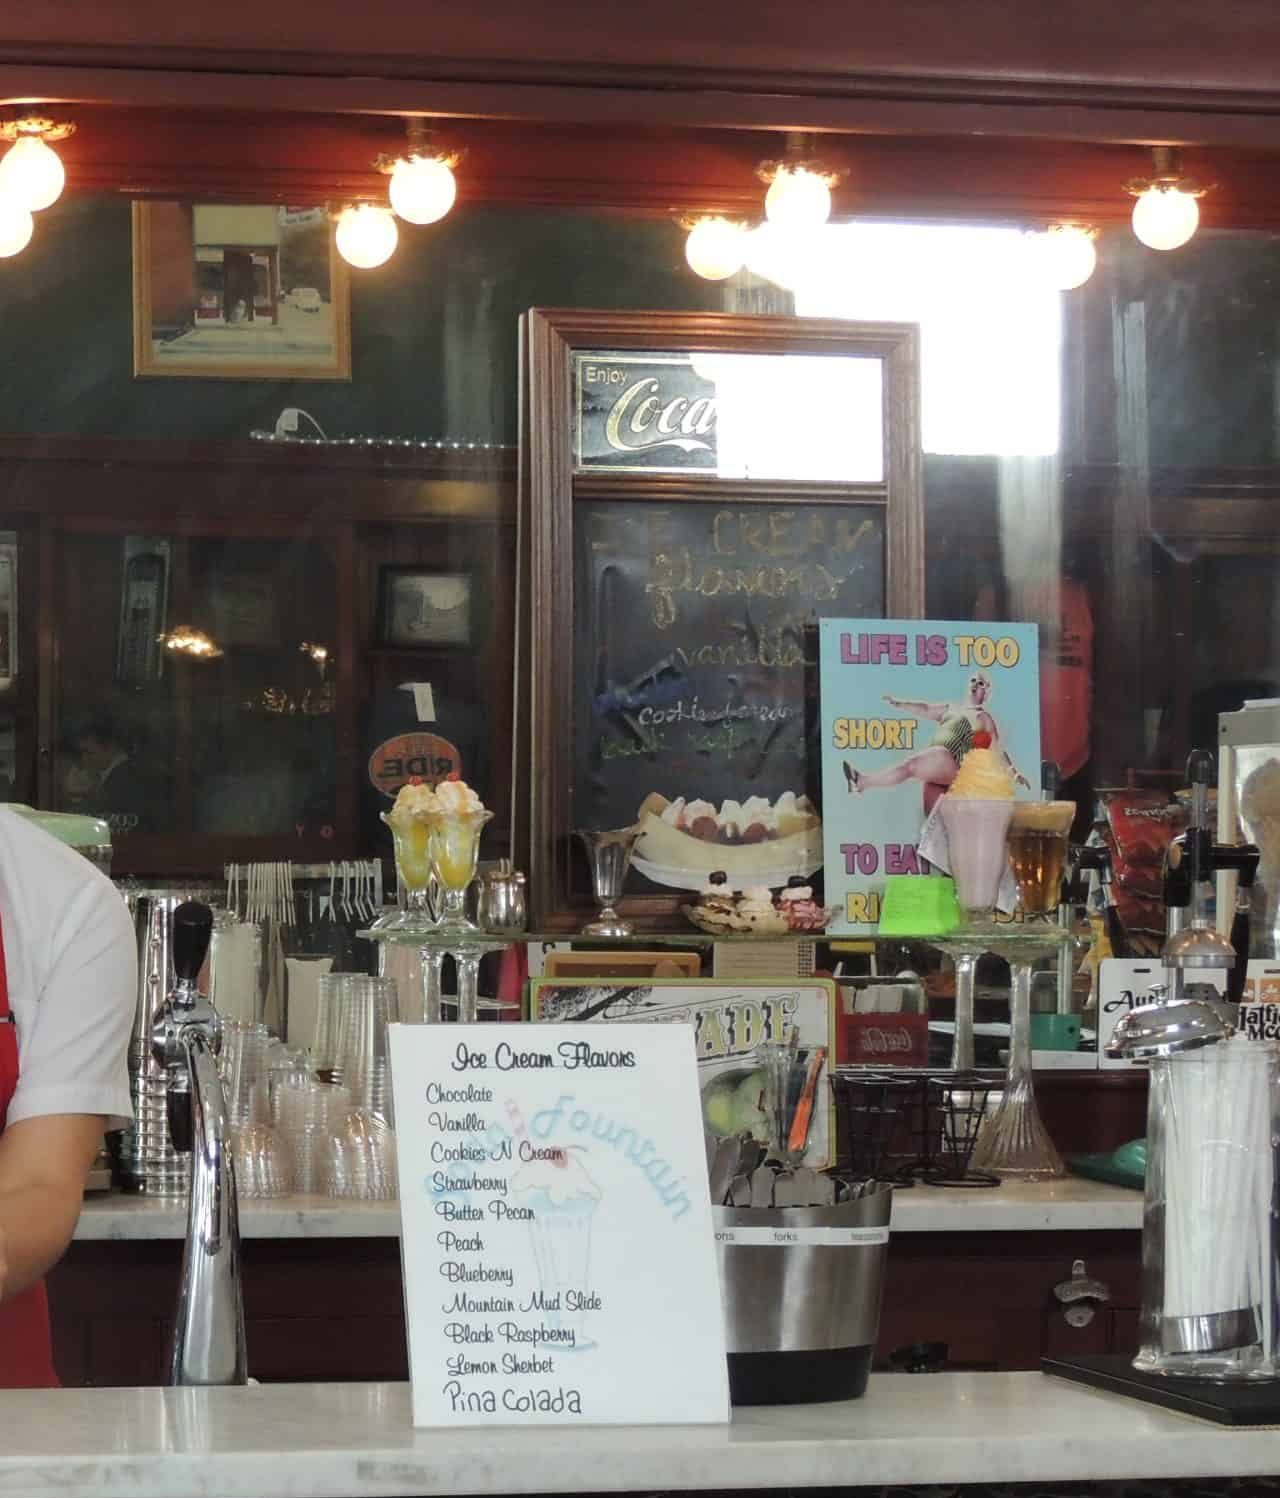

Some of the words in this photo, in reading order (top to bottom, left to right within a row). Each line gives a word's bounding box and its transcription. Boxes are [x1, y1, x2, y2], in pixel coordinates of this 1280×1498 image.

[585, 366, 628, 385] Enjoy
[840, 633, 908, 666] LIFE
[915, 635, 948, 666] IS
[953, 635, 1020, 668] TOO
[832, 716, 918, 750] SHORT
[840, 843, 879, 875] TO
[451, 1042, 487, 1071] Ice
[495, 1042, 554, 1071] Cream
[558, 1041, 636, 1070] Flavors
[426, 1083, 493, 1105] Chocolate
[428, 1112, 486, 1133] Vanilla
[431, 1142, 486, 1163] Cookies
[490, 1140, 512, 1161] N
[519, 1141, 563, 1162] Cream
[432, 1171, 507, 1196] Strawberry
[435, 1201, 484, 1222] Butter
[488, 1200, 535, 1221] Pecan
[437, 1231, 484, 1252] Peach
[774, 1231, 798, 1241] forks
[439, 1262, 513, 1286] Blueberry
[442, 1291, 514, 1314] Mountain
[519, 1291, 561, 1313] Mud
[566, 1290, 602, 1312] Slide
[444, 1322, 494, 1344] Black
[498, 1322, 575, 1348] Raspberry
[447, 1353, 498, 1376] Lemon
[502, 1353, 554, 1375] Sherbet
[443, 1380, 497, 1413] Pina
[502, 1387, 582, 1414] Colada
